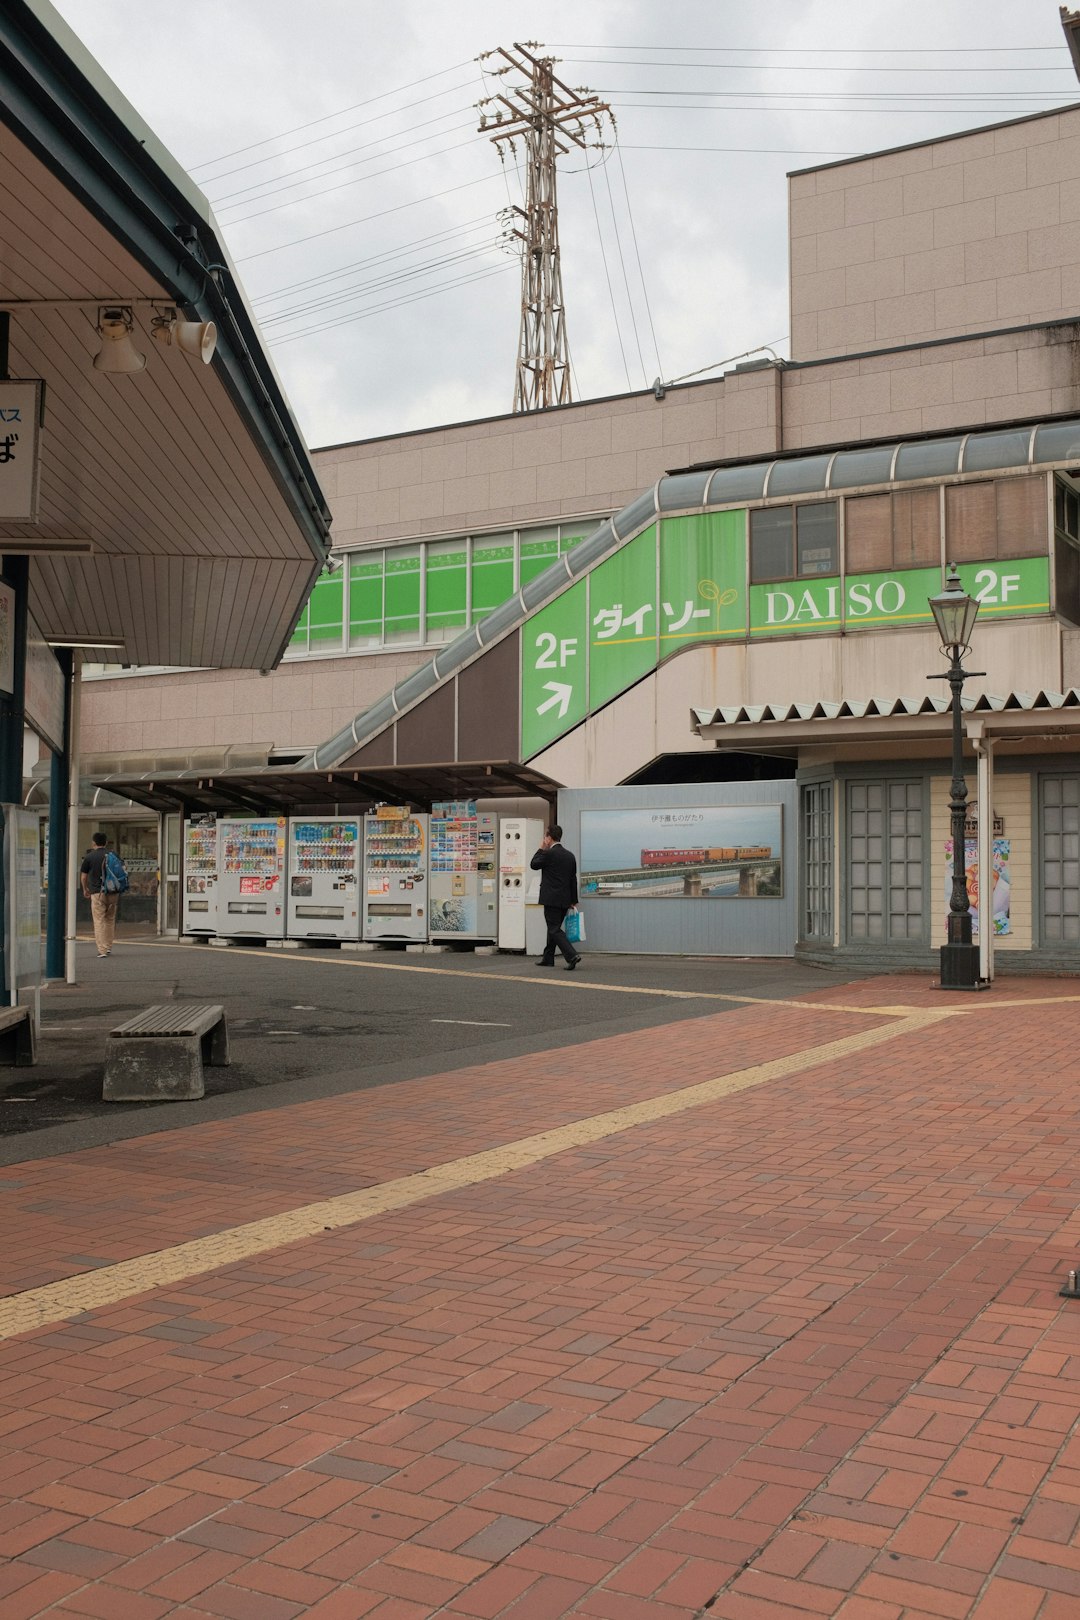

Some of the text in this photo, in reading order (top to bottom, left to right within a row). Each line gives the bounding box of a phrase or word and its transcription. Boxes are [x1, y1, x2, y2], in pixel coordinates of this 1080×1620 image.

[765, 580, 906, 624] DAISO
[974, 569, 1021, 604] 2F
[593, 600, 711, 639] ダイソー
[535, 632, 578, 669] 2F
